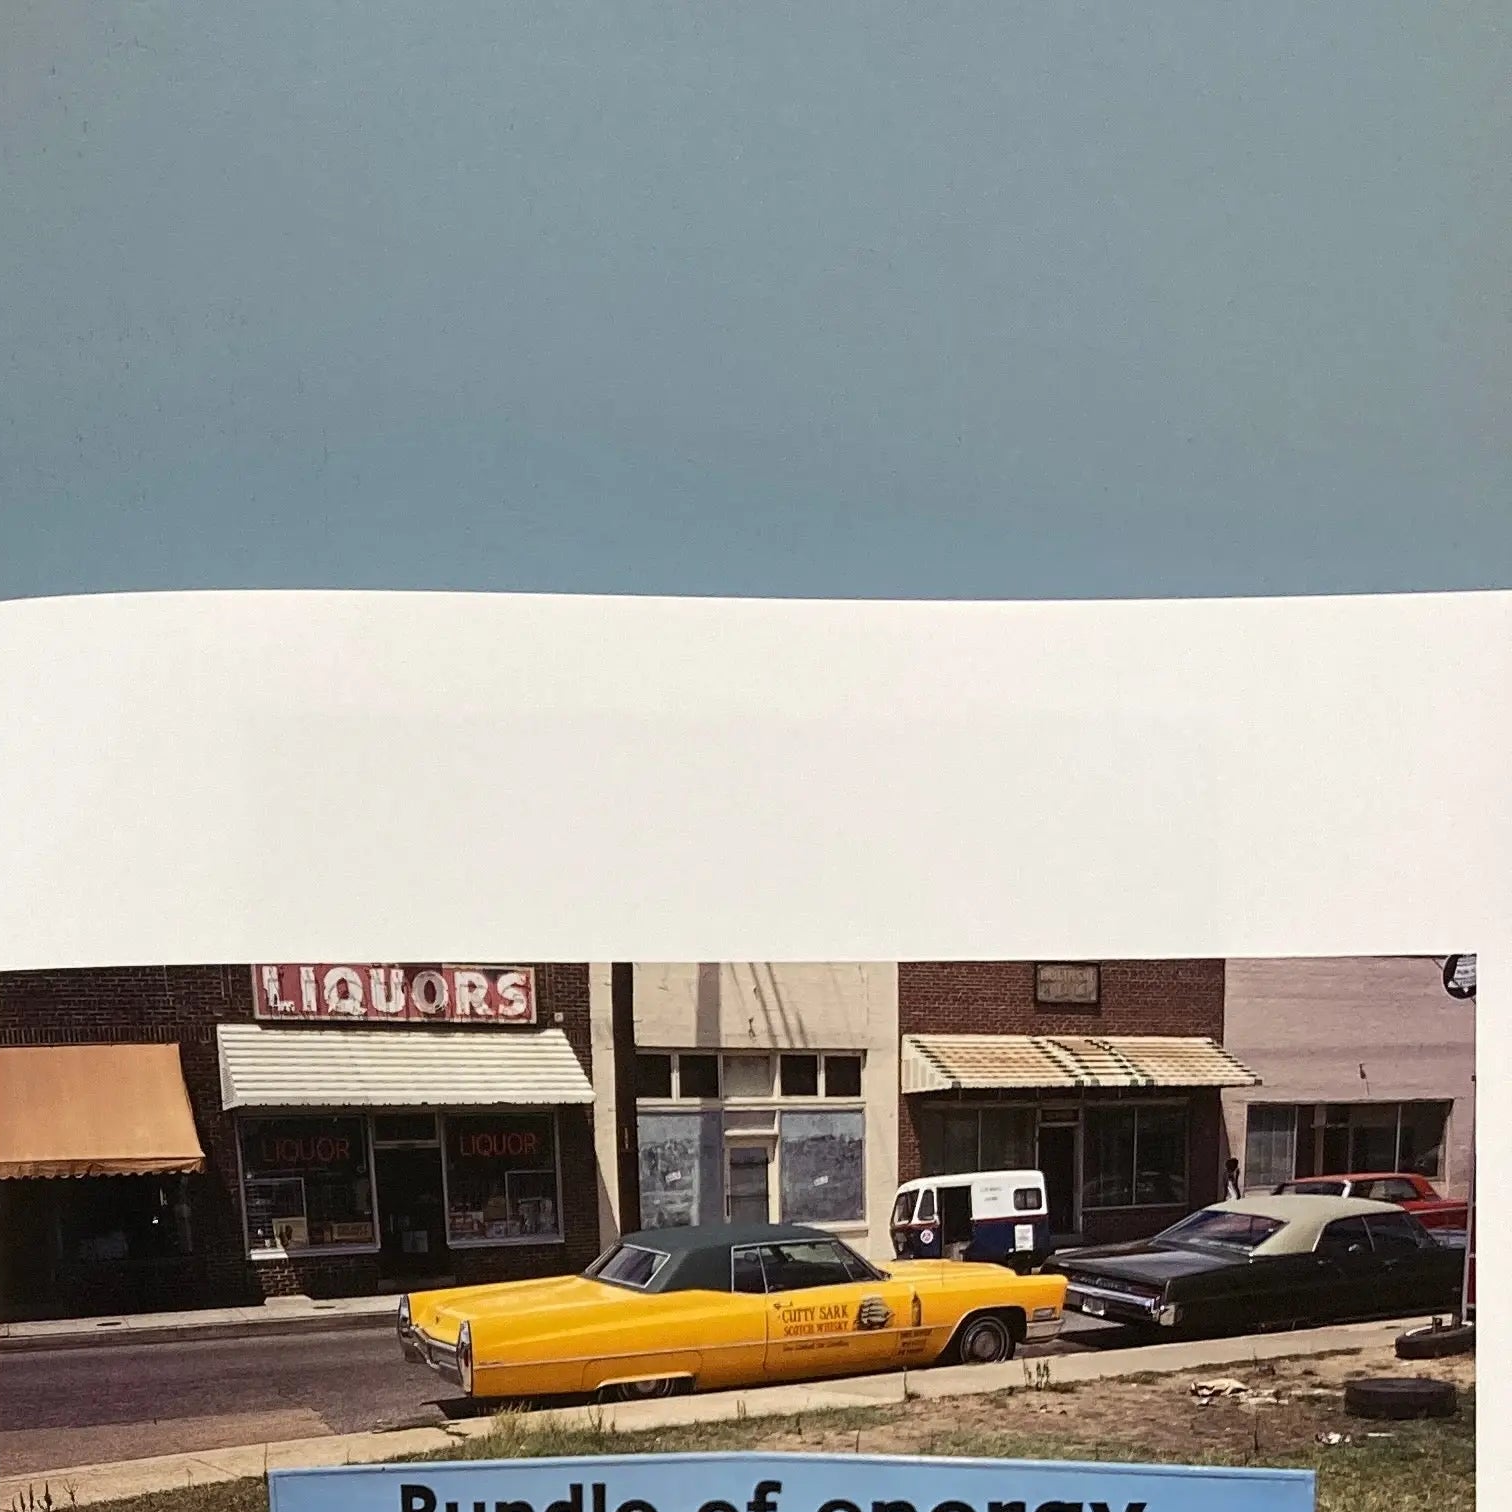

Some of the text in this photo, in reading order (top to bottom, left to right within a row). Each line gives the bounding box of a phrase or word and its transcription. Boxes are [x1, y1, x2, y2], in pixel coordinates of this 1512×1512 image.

[261, 964, 528, 1017] LIQUORS
[262, 1135, 350, 1163] LIQUOR
[459, 1131, 538, 1158] LIQUOR
[781, 1303, 849, 1324] CUTTY SARK
